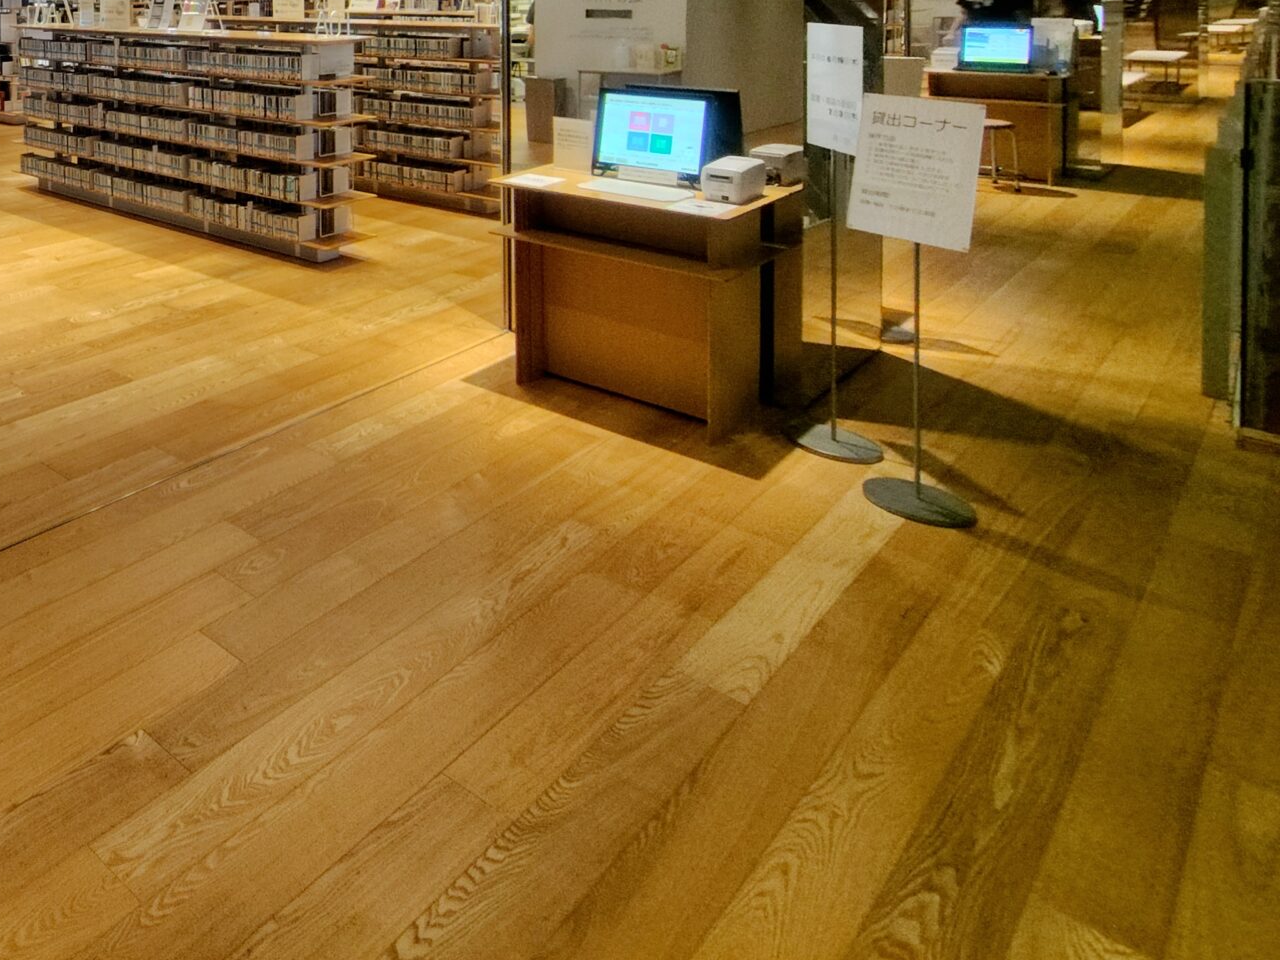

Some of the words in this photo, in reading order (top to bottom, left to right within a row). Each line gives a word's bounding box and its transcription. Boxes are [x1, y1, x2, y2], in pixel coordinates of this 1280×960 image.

[871, 111, 968, 133] 貸出コーナー
